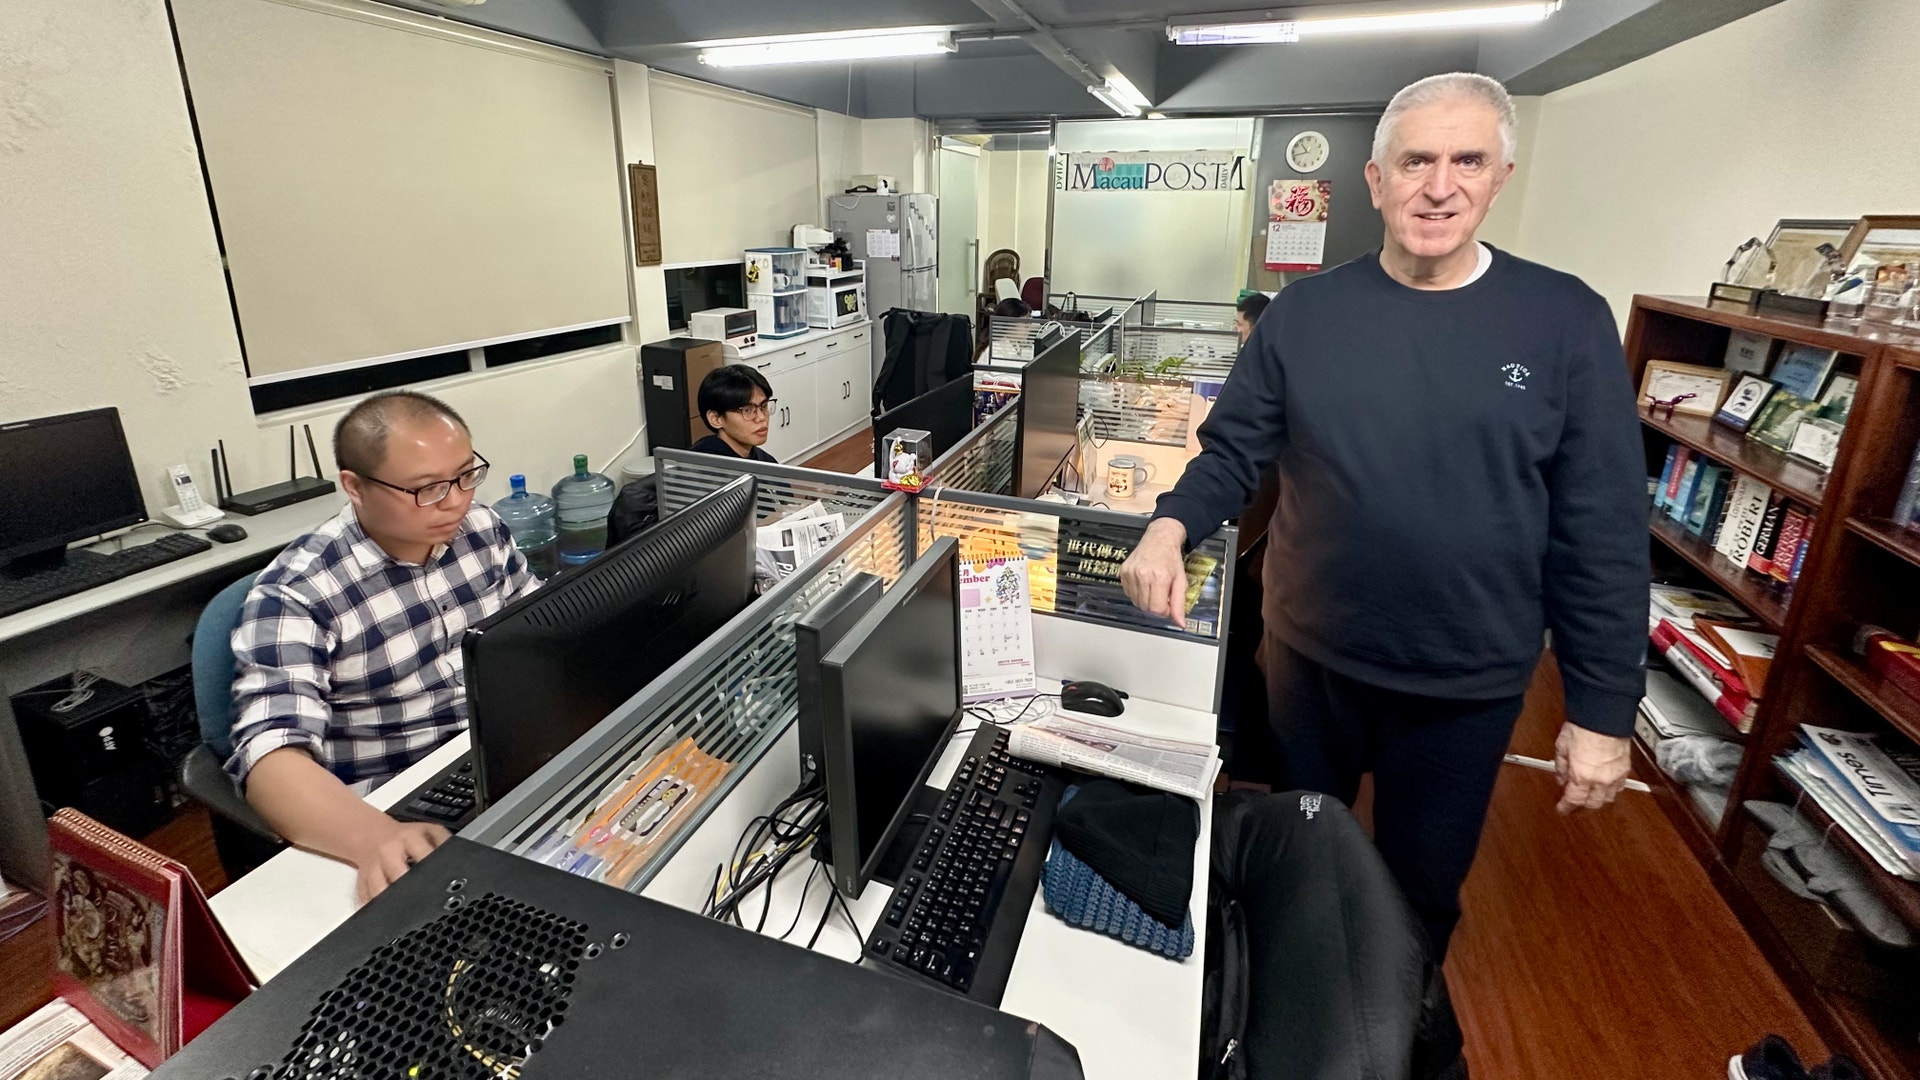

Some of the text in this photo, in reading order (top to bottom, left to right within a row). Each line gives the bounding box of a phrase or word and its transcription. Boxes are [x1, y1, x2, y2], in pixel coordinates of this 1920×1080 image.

[1071, 163, 1145, 190] Macau
[1145, 162, 1228, 190] POST
[1285, 185, 1315, 216] 福
[1272, 224, 1280, 232] 12
[1732, 496, 1762, 562] ROBERT
[1756, 506, 1780, 555] GERMAN
[1067, 538, 1128, 560] 世代傳承
[1837, 752, 1894, 797] Times
